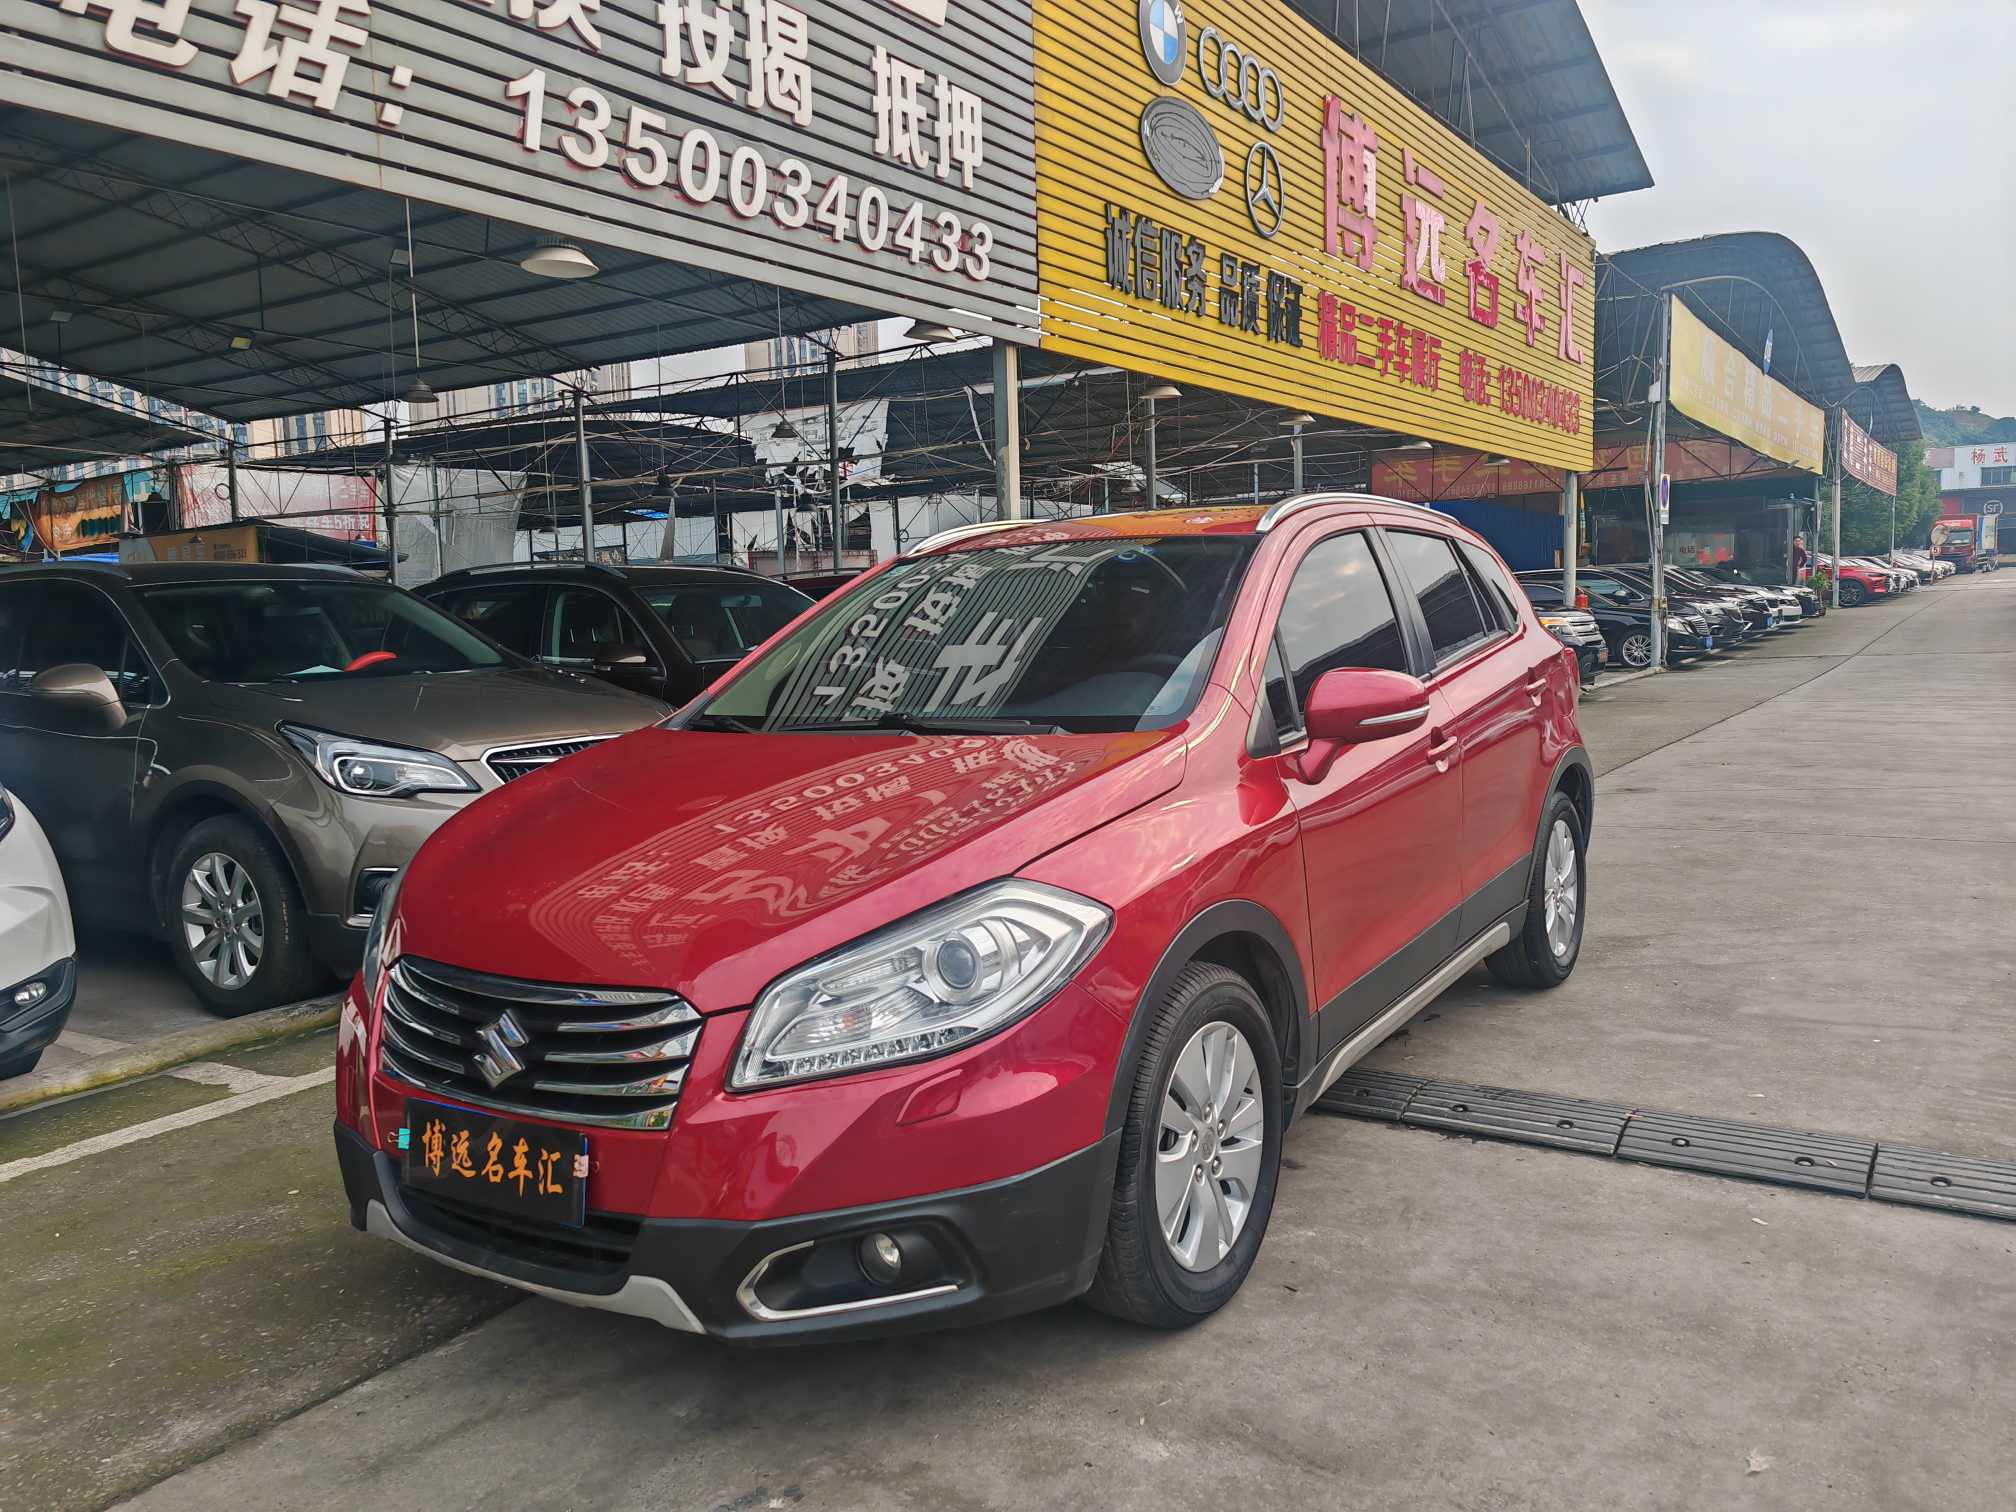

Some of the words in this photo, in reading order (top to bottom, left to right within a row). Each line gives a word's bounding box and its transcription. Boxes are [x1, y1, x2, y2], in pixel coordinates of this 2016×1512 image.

[505, 68, 993, 282] 13500340433
[871, 44, 984, 189] 抵押
[1104, 202, 1207, 317] 诚信服务
[1320, 94, 1585, 365] 博远名车汇
[421, 1118, 564, 1198] 博远名车汇
